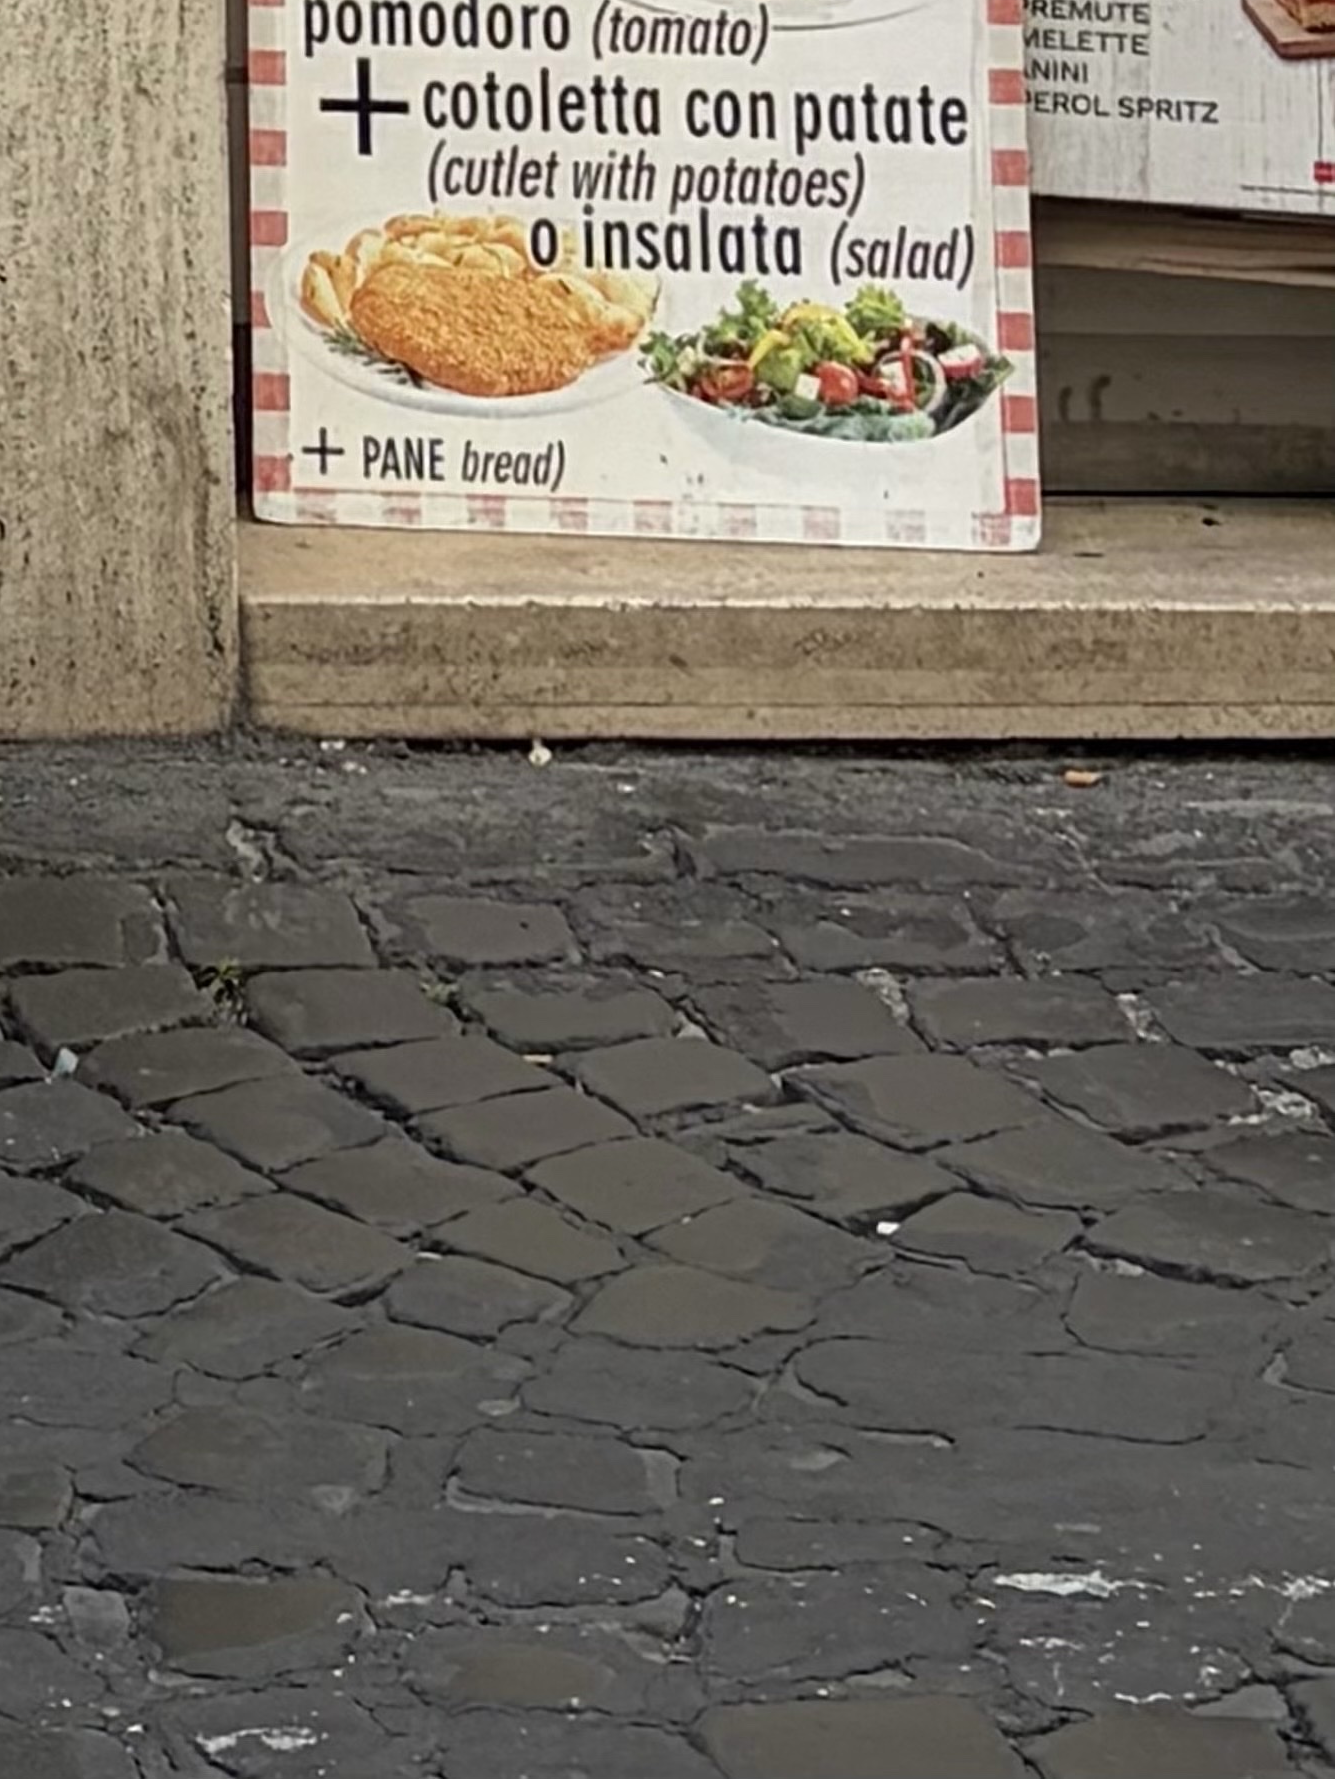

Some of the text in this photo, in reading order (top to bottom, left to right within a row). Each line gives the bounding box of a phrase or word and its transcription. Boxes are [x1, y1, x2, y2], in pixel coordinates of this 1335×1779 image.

[1023, 60, 1089, 84] NINI
[423, 66, 661, 137] cotoletta
[685, 88, 777, 140] con
[793, 83, 969, 157] patate
[1024, 92, 1219, 125] EROL SPRITZ
[428, 138, 866, 218] (cutlet with potatoes)
[529, 203, 975, 291] o insalata (salad)
[362, 435, 446, 482] PANE
